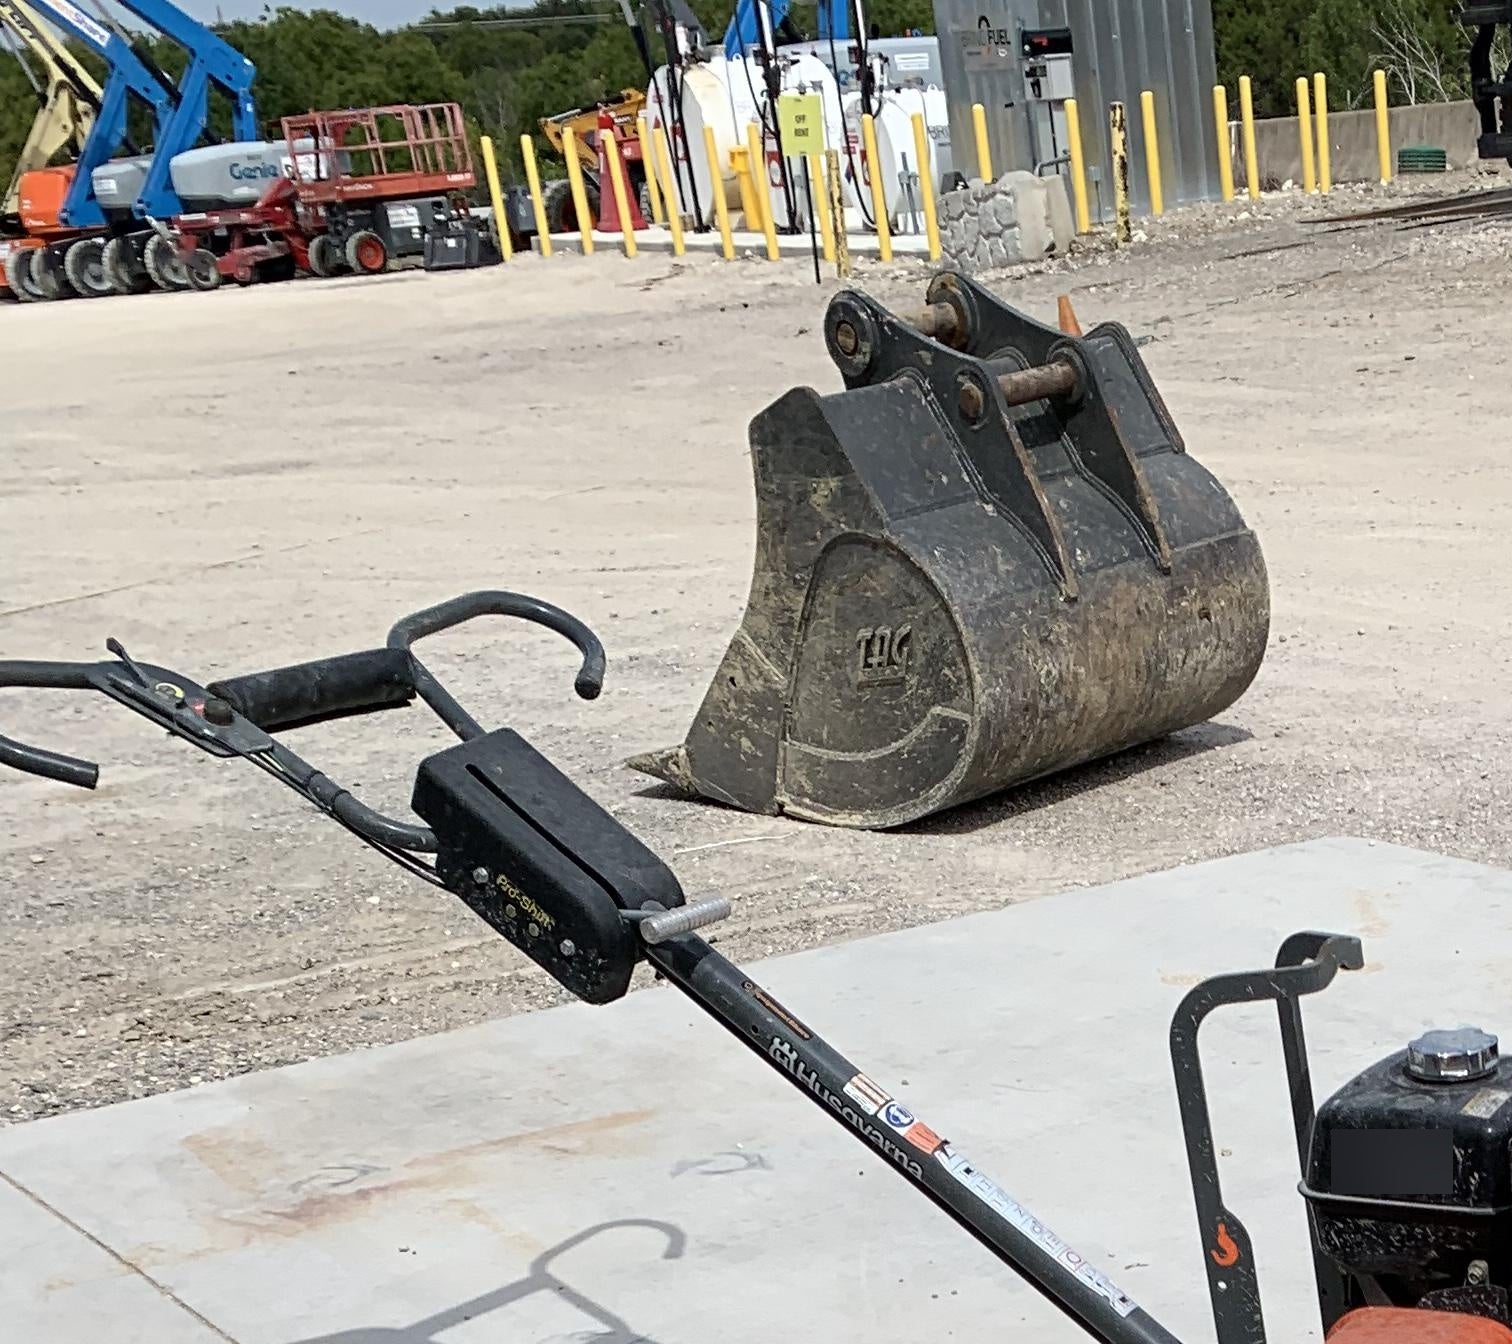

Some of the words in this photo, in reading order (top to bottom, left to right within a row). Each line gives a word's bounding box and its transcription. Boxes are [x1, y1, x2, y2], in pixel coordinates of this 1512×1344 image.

[987, 29, 1011, 45] FUEL
[229, 162, 279, 179] Genie
[797, 1061, 923, 1180] Husqvarna
